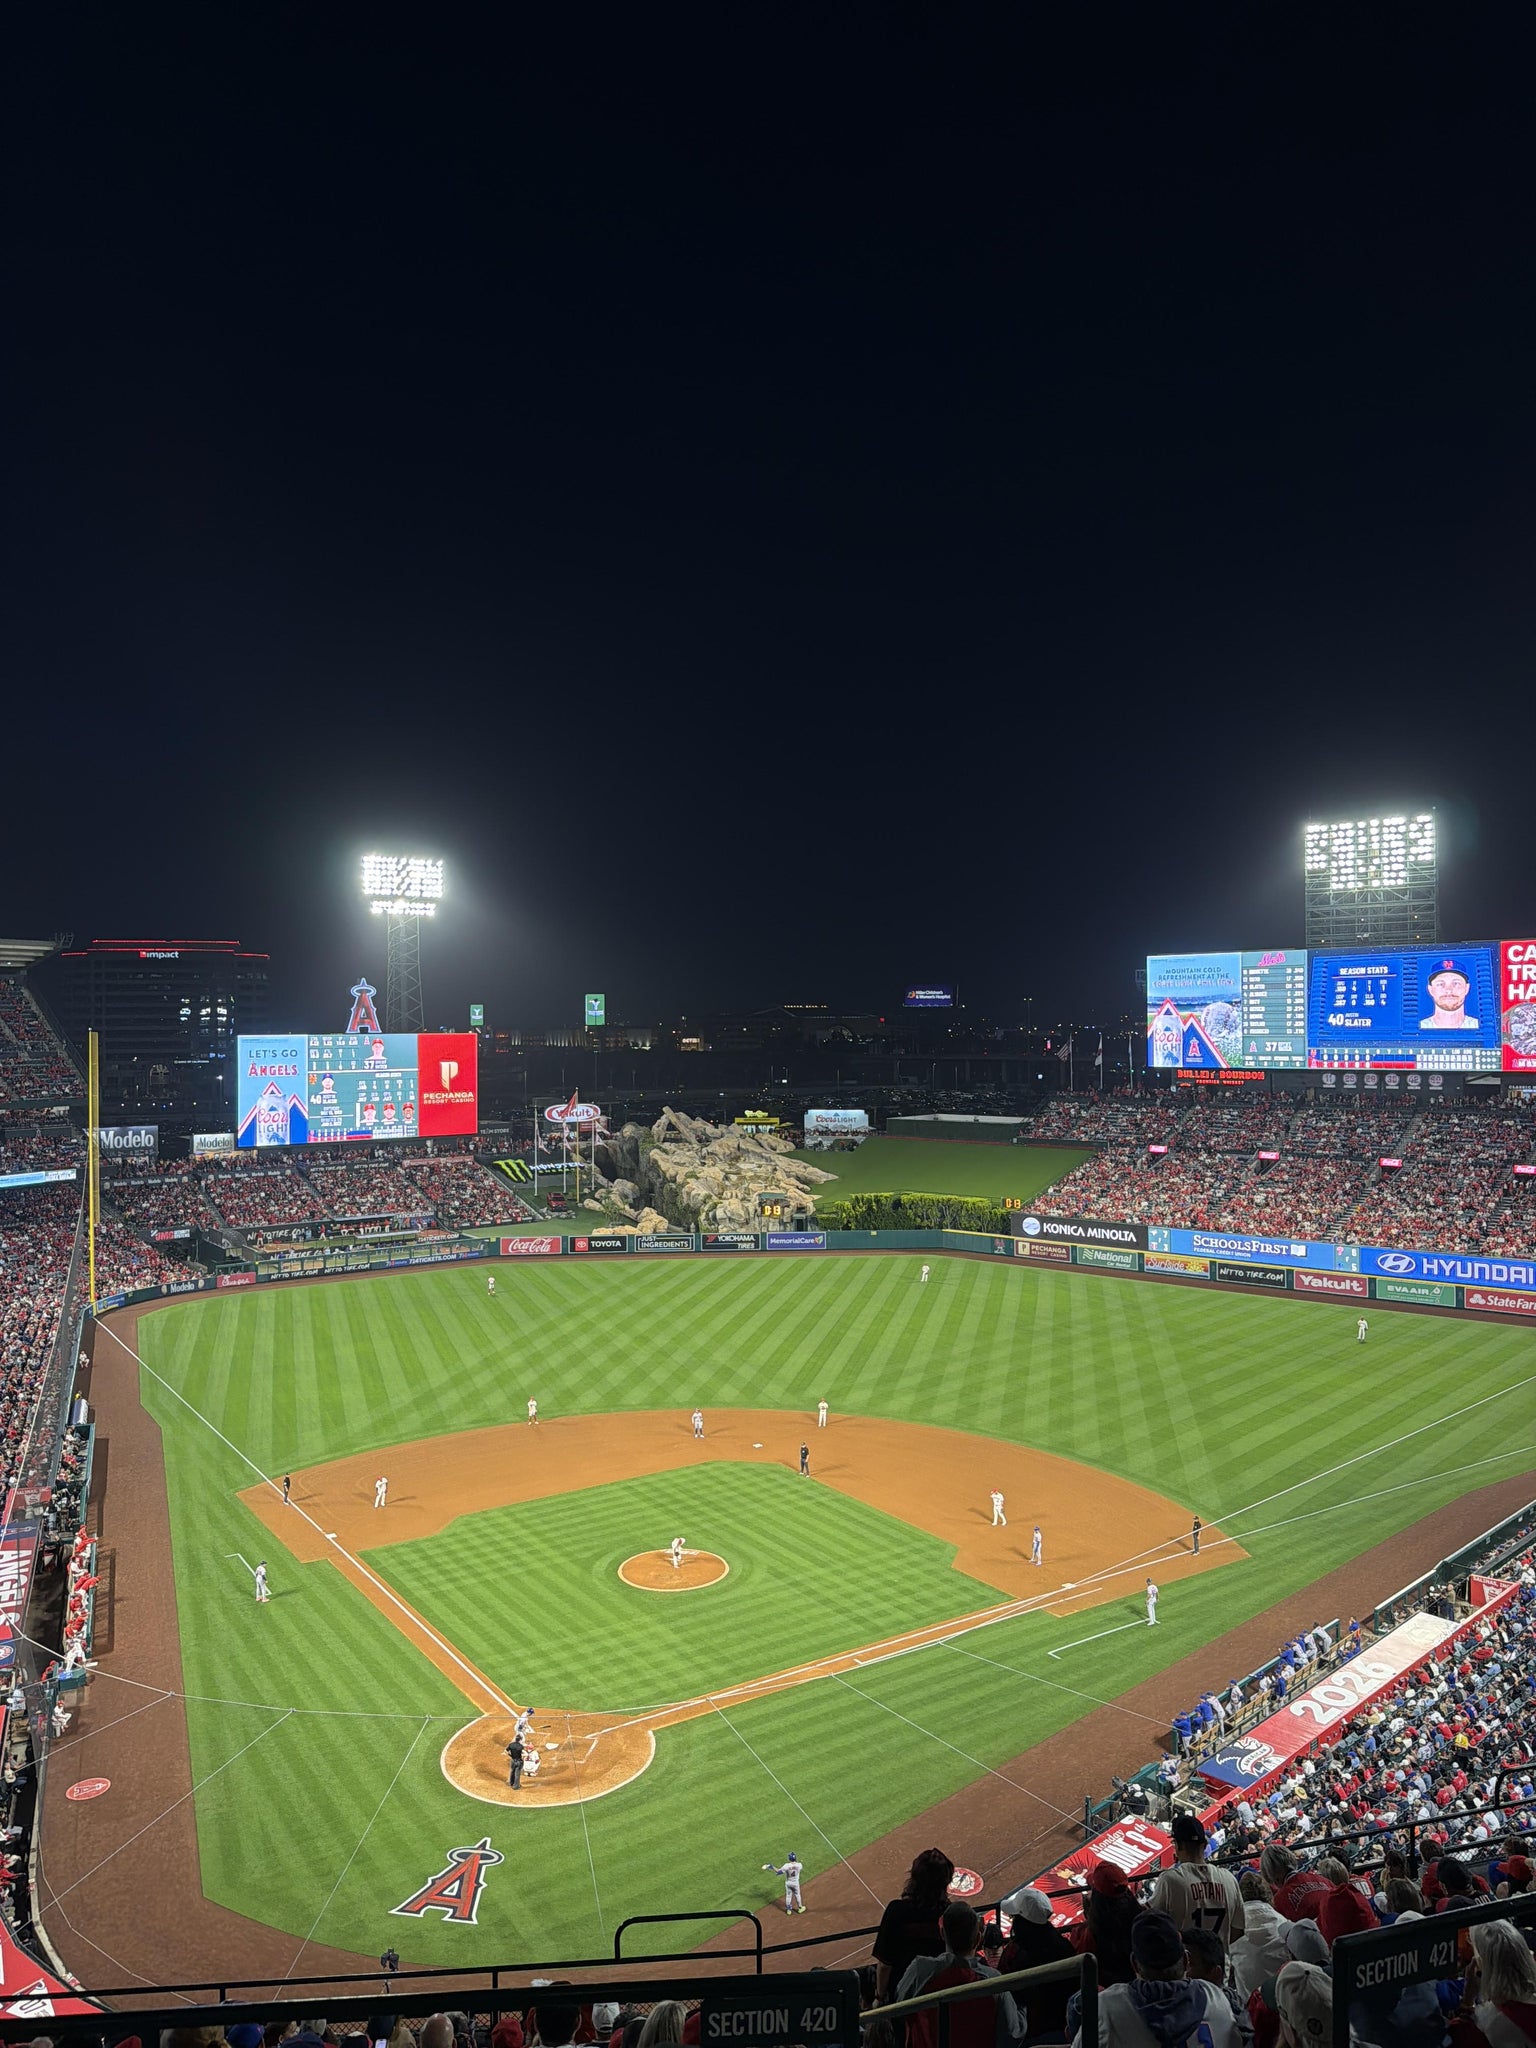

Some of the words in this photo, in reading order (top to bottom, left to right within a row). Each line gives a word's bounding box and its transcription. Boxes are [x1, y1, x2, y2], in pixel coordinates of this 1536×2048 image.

[147, 951, 179, 959] impact
[1340, 967, 1366, 975] SEASON
[1367, 966, 1388, 974] STATS
[1328, 1014, 1344, 1026] 40
[1345, 1019, 1371, 1027] SLATER
[1265, 1042, 1278, 1051] 37
[249, 1049, 278, 1058] LET'S
[281, 1049, 298, 1057] GO
[249, 1061, 299, 1076] ANGELS
[364, 1061, 375, 1069] 37
[1219, 1070, 1265, 1080] BOURBON
[310, 1095, 321, 1104] 40
[815, 1115, 837, 1123] Coors
[101, 1129, 154, 1149] Modelo
[200, 1137, 230, 1148] Modelo
[1043, 1222, 1085, 1237] KONICA
[1087, 1227, 1137, 1242] MINOLTA
[508, 1238, 552, 1253] Coca-Cola
[591, 1240, 622, 1248] TOYOTA
[769, 1237, 815, 1245] MemorialCare
[1031, 1244, 1067, 1254] PECHANGA
[409, 1254, 456, 1264] 714TICKETS.COM
[1093, 1250, 1133, 1263] National
[1148, 1256, 1185, 1270] Surfside
[291, 1270, 318, 1278] TIRE.COM
[344, 1263, 370, 1271] TIRE.COM
[1220, 1267, 1244, 1276] NITTO
[1246, 1271, 1284, 1282] TIRE.COM
[1423, 1258, 1534, 1285] HYUNDAI
[170, 1282, 194, 1294] Modelo
[1299, 1275, 1363, 1292] Yakult
[1387, 1285, 1409, 1293] EVA
[1408, 1287, 1429, 1295] AIR
[1487, 1296, 1516, 1307] State
[1290, 1659, 1396, 1725] 2026
[1088, 1828, 1125, 1854] Monday
[1191, 1881, 1224, 1901] OHTANI
[1191, 1907, 1226, 1934] 17
[1356, 1950, 1419, 1989] SECTION
[1429, 1940, 1455, 1967] 421
[708, 2009, 789, 2037] SECTION
[800, 2006, 837, 2032] 420
